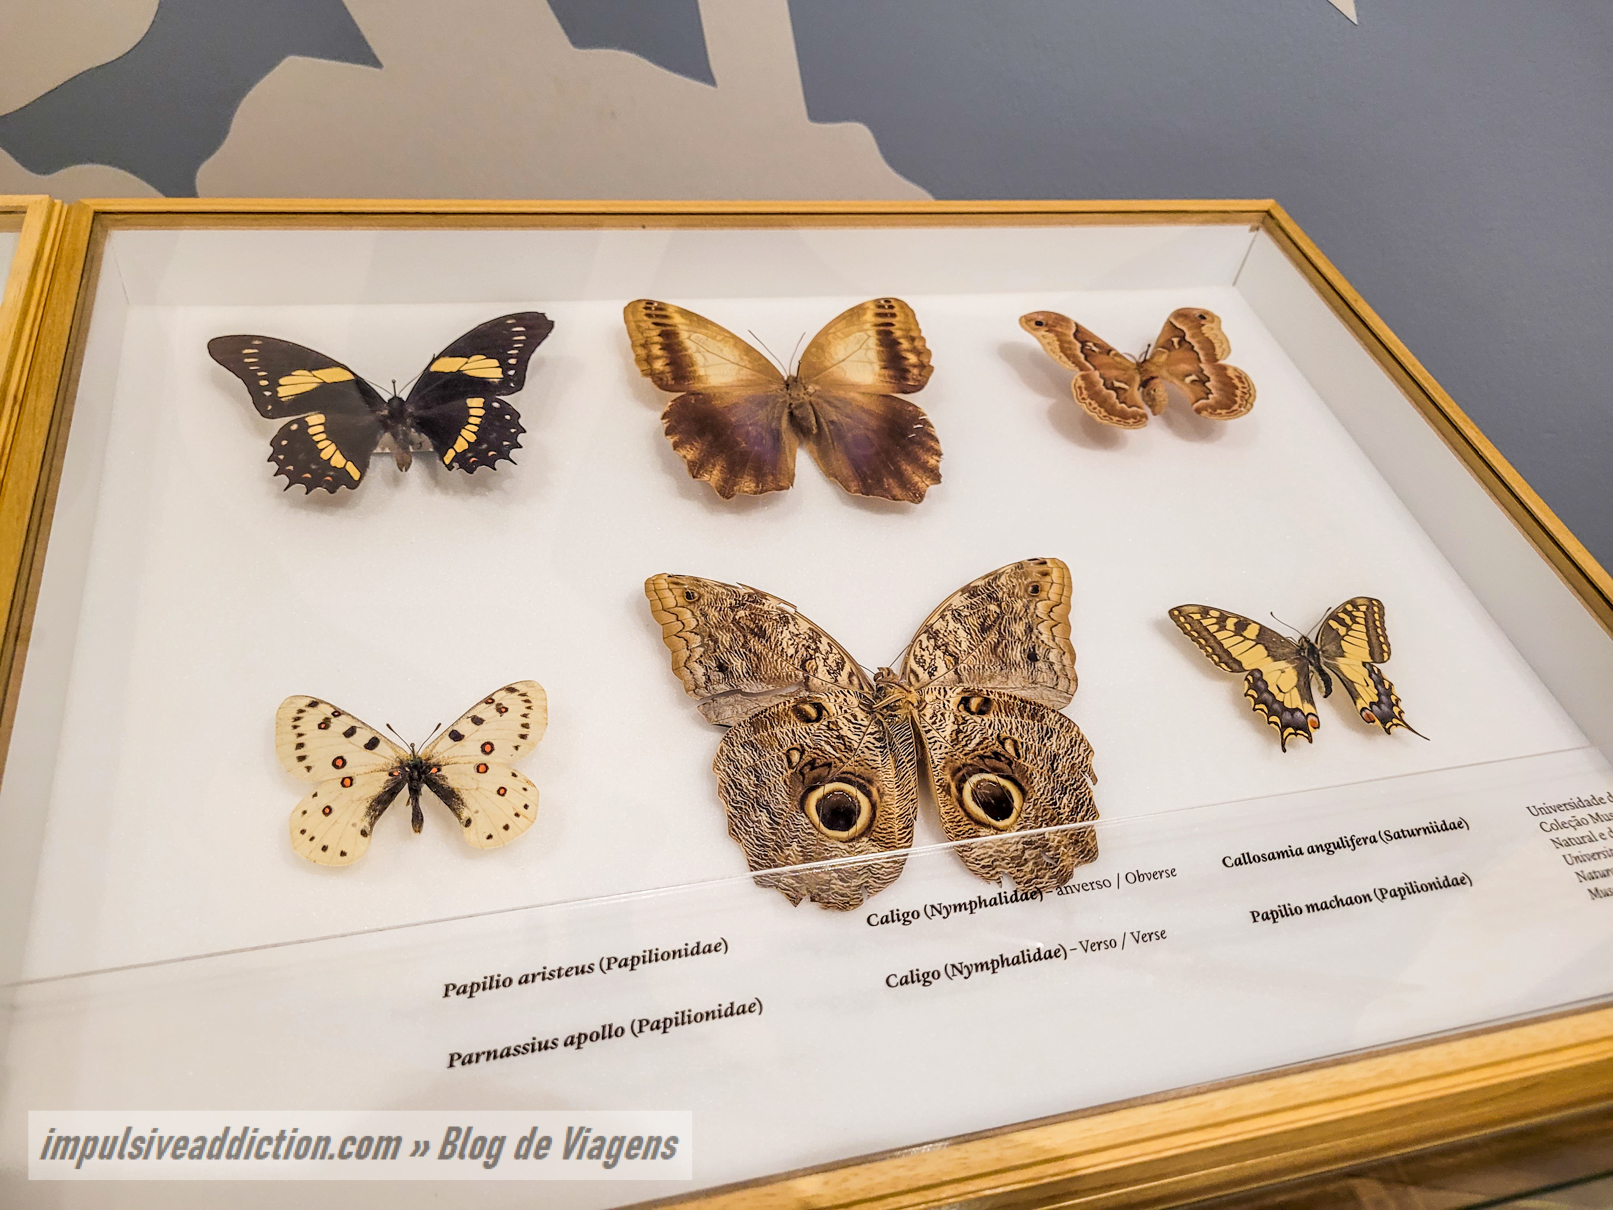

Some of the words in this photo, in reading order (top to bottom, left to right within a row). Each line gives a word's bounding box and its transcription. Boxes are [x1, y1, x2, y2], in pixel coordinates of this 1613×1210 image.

[1526, 794, 1607, 817] Universidade
[1539, 815, 1590, 833] Coleção
[1222, 845, 1305, 868] Callosamia
[1307, 832, 1379, 856] angulifera
[1378, 817, 1470, 845] (Saturniidae)
[1549, 831, 1599, 849] Natural
[1599, 831, 1608, 841] e
[866, 908, 920, 927] Caligo
[924, 886, 1044, 920] (Nymphalidae)
[1055, 878, 1112, 897] anverso
[1125, 865, 1178, 884] Obverse
[1250, 904, 1303, 924] Papilio
[1306, 891, 1372, 913] machaon
[1374, 872, 1474, 903] (Papilionidae)
[442, 973, 513, 999] Papilio
[518, 959, 595, 985] aristeus
[599, 937, 729, 974] (Papilionidae)
[885, 967, 941, 988] Caligo
[944, 943, 1068, 981] (Nymphalidae)
[1079, 937, 1117, 954] Verso
[1131, 927, 1168, 944] Verse
[447, 1036, 559, 1069] Parnassius
[563, 1023, 626, 1051] apollo
[630, 997, 764, 1038] (Papilionidae)
